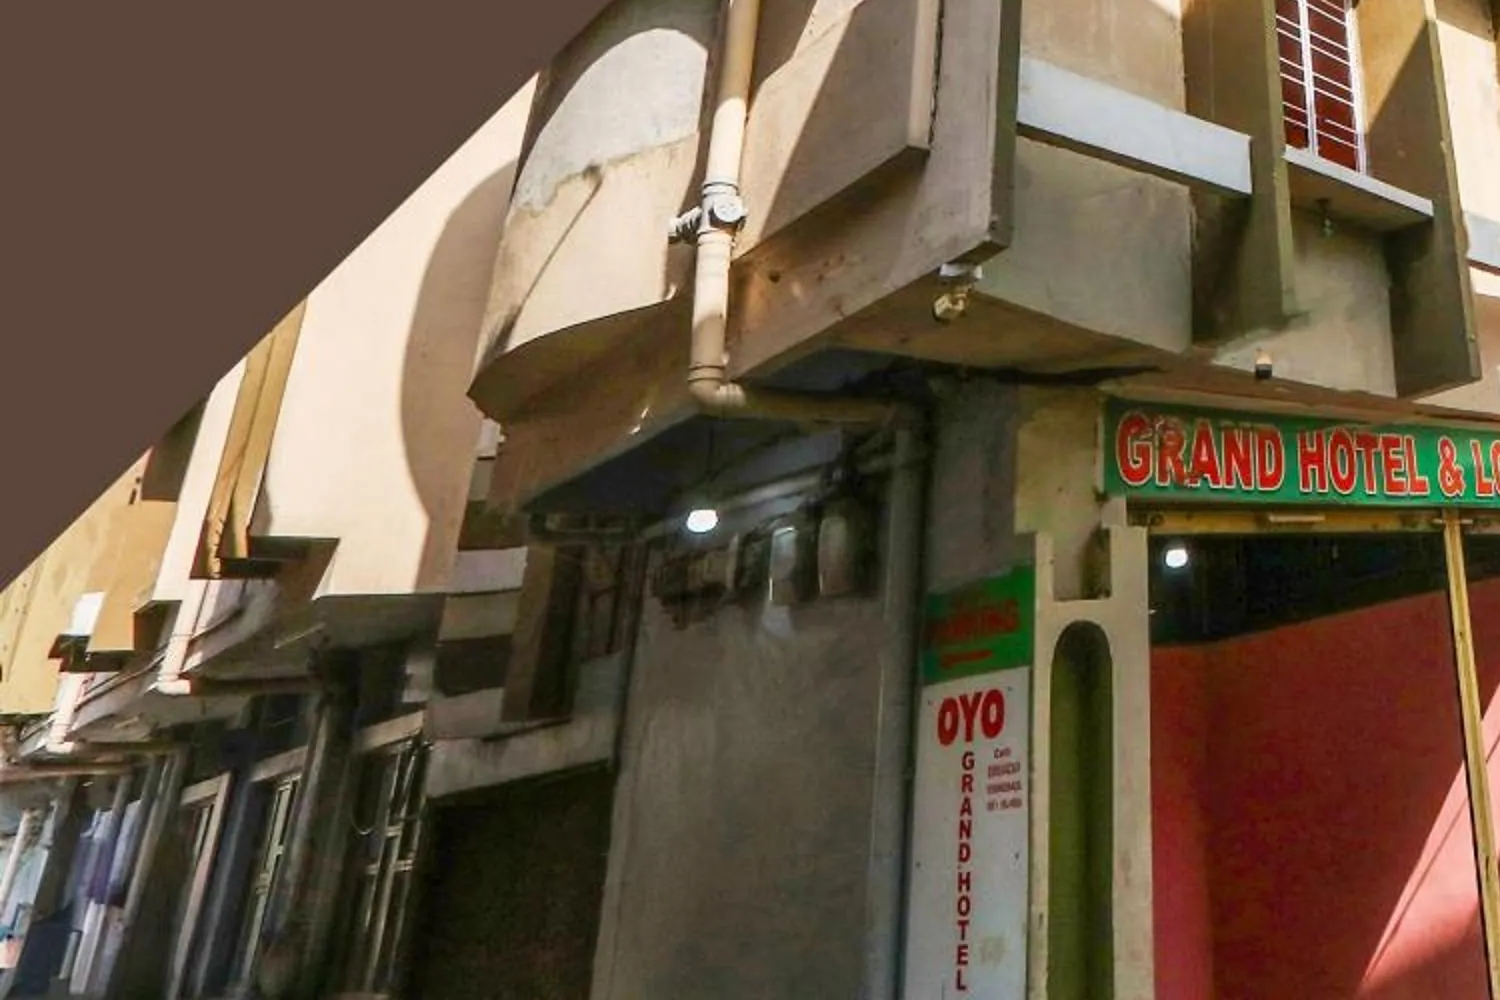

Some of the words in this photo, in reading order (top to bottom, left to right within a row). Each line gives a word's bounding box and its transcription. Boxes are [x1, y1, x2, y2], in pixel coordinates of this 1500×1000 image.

[1116, 412, 1284, 490] GRAND
[1299, 425, 1429, 496] HOTEL
[1439, 434, 1467, 497] &
[938, 689, 1005, 746] OYO
[957, 752, 976, 864] GRAND
[955, 871, 972, 991] HOTEL
